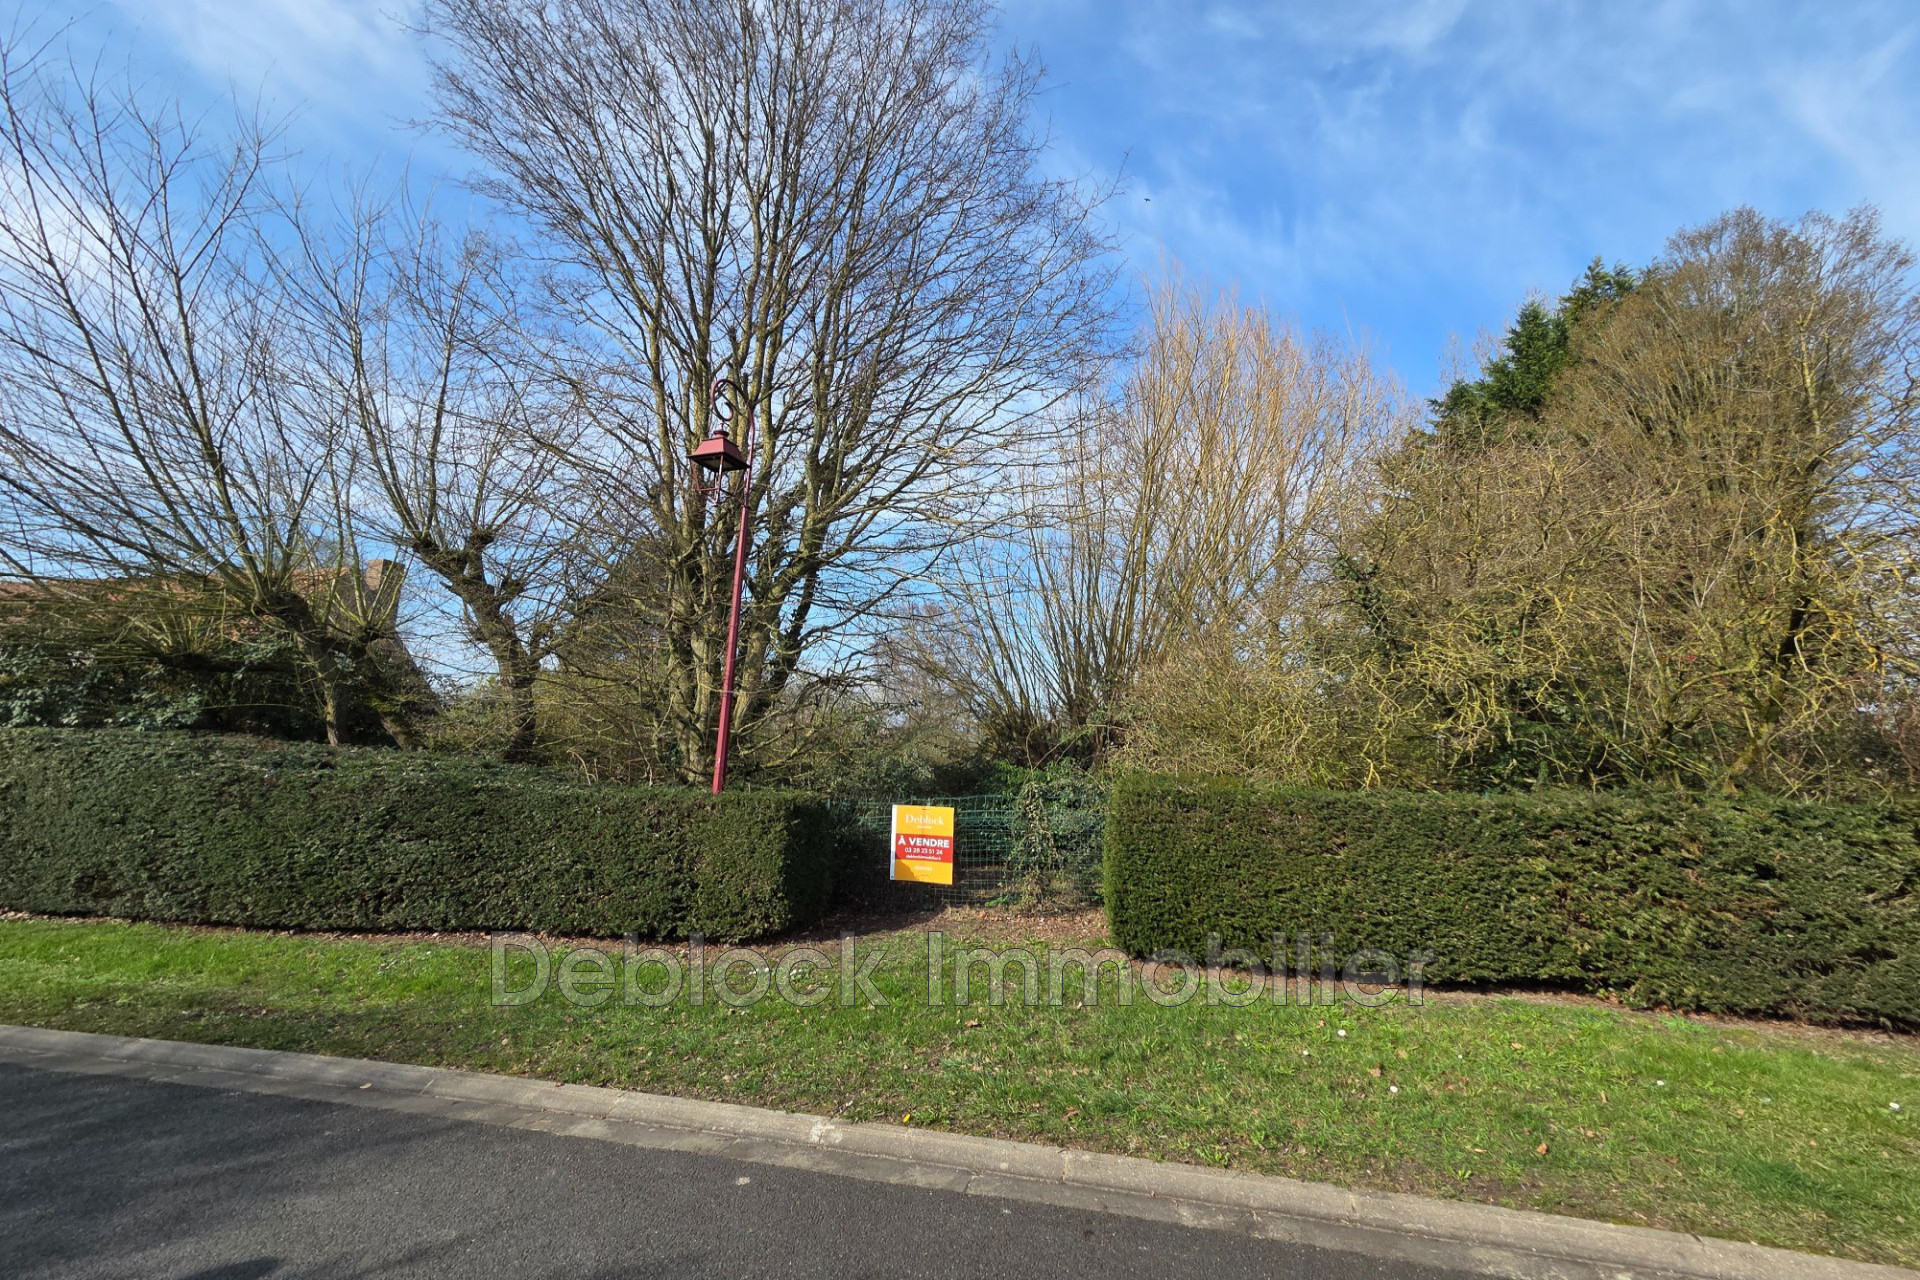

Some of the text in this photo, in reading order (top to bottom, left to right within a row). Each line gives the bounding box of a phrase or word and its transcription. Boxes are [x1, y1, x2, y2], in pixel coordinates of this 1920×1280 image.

[905, 814, 944, 825] Deblock
[898, 834, 950, 848] À VENDRE
